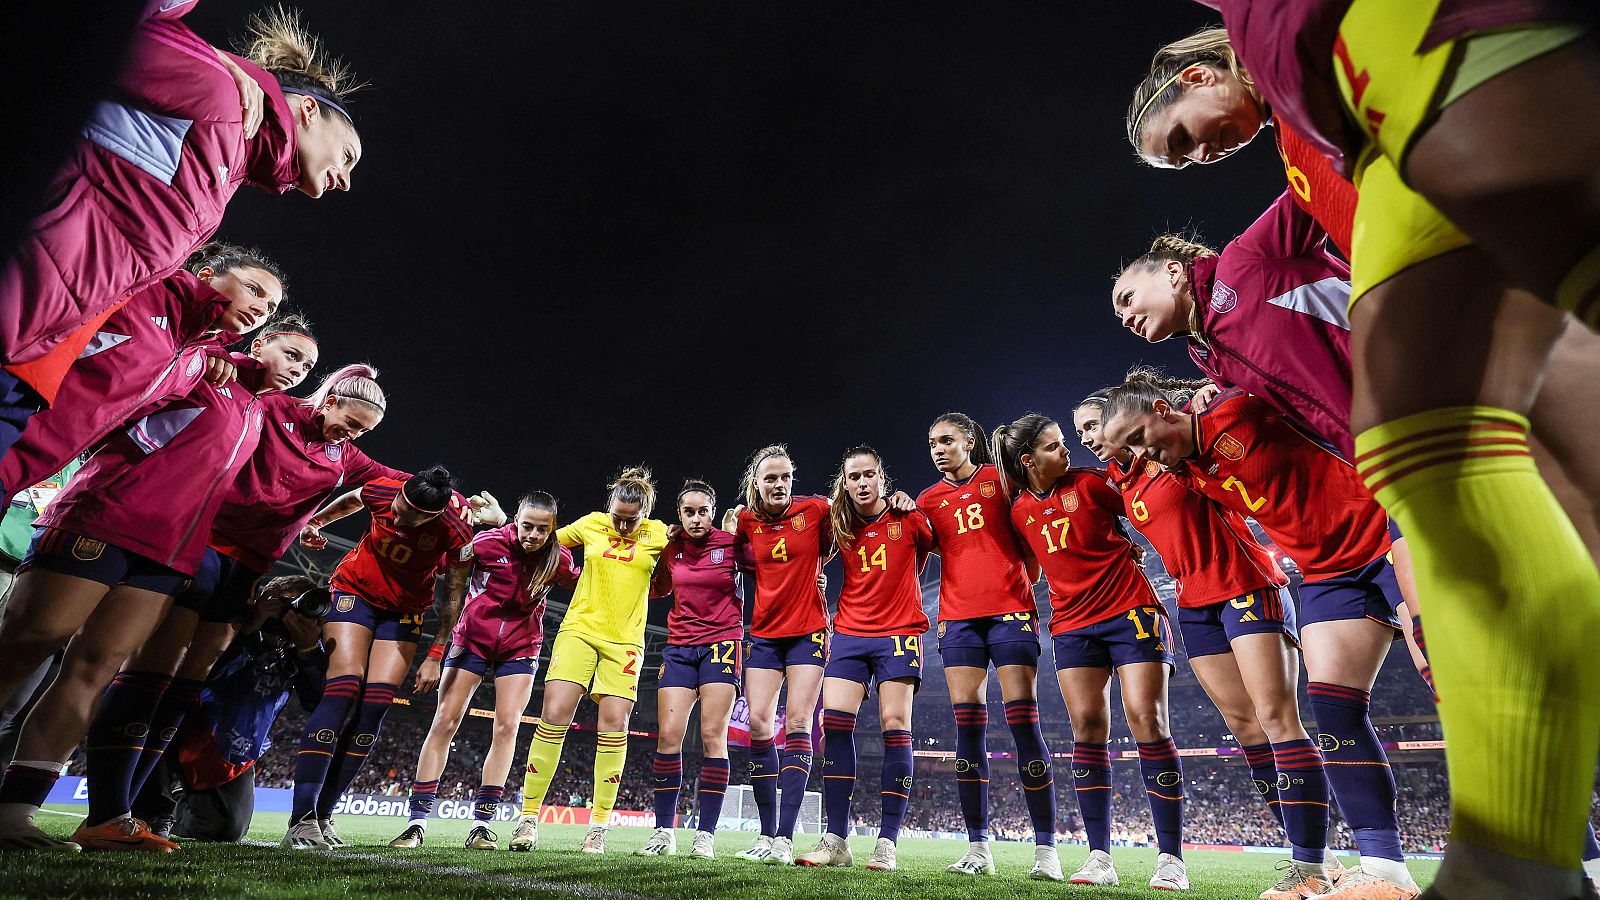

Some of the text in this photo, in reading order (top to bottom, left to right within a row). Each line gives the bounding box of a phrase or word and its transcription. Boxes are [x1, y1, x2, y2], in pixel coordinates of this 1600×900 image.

[1131, 490, 1149, 521] 6
[1221, 475, 1267, 512] 2
[954, 503, 985, 535] 18
[1041, 516, 1070, 554] 17
[380, 537, 413, 564] 10
[602, 536, 638, 563] 23
[771, 537, 788, 562] 4
[857, 543, 887, 573] 14
[1126, 606, 1161, 640] 17
[709, 640, 735, 665] 12
[811, 631, 825, 650] 4
[890, 635, 919, 657] 14
[622, 650, 637, 675] 2
[392, 697, 411, 706] INAL
[332, 793, 412, 817] Globant
[898, 827, 933, 840] AIRWAYS
